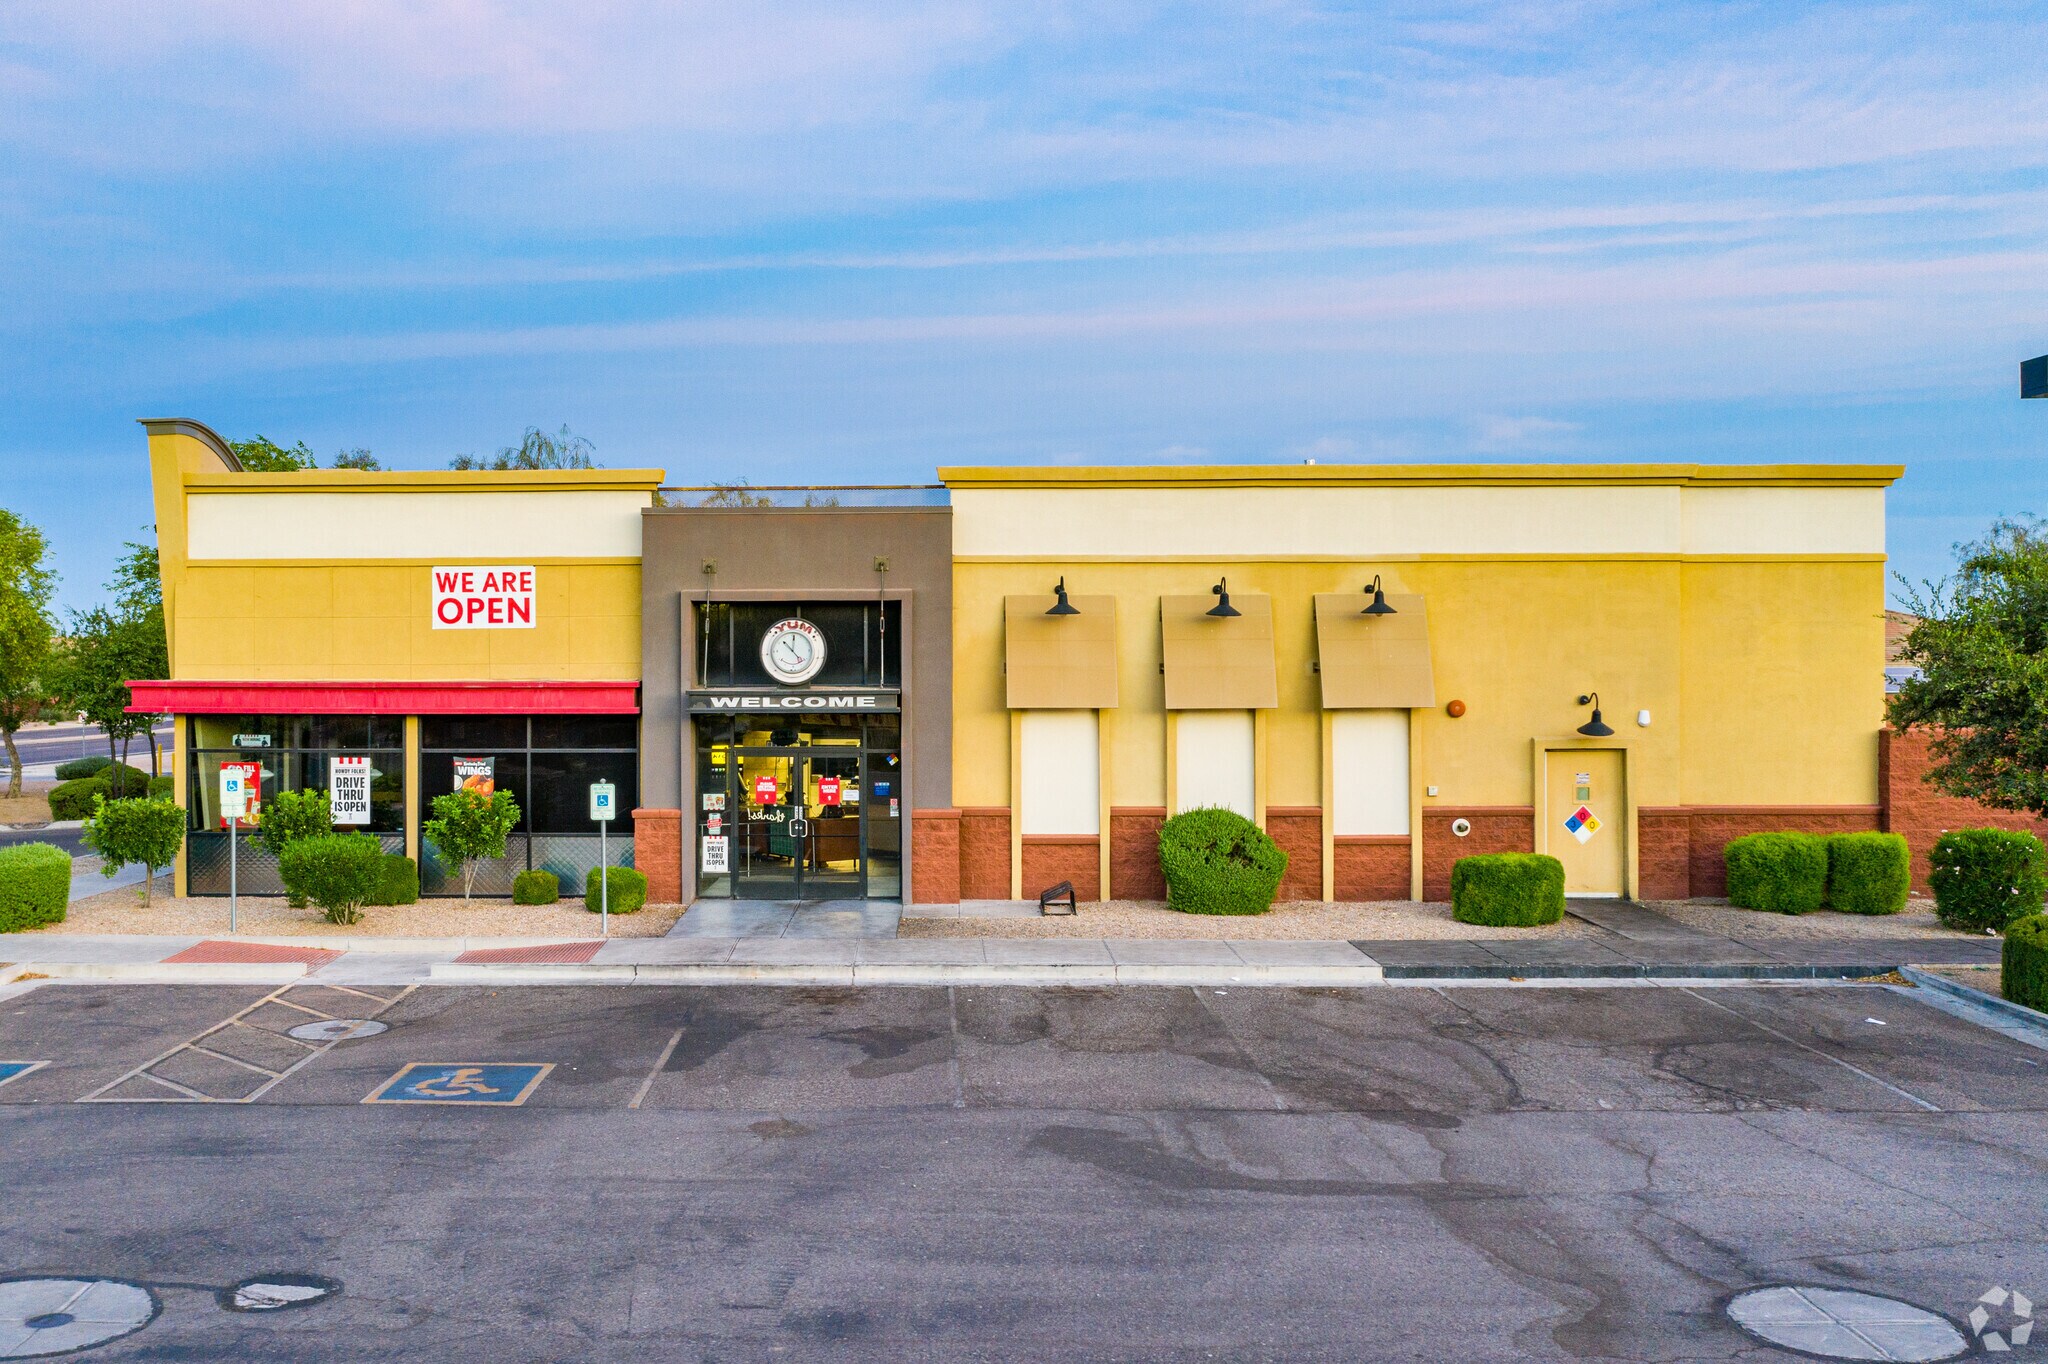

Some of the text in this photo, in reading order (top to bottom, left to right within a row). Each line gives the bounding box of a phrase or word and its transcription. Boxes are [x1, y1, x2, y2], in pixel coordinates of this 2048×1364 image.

[436, 572, 532, 593] WE ARE
[437, 597, 530, 624] OPEN
[775, 620, 813, 635] YUM
[710, 696, 876, 708] WELCOME
[457, 766, 491, 776] WINGS
[336, 777, 365, 788] DRIVE
[337, 789, 364, 800] THRU
[334, 801, 366, 812] IS OPEN
[1580, 812, 1586, 821] 0
[1570, 820, 1576, 828] 3
[1589, 821, 1595, 829] 0
